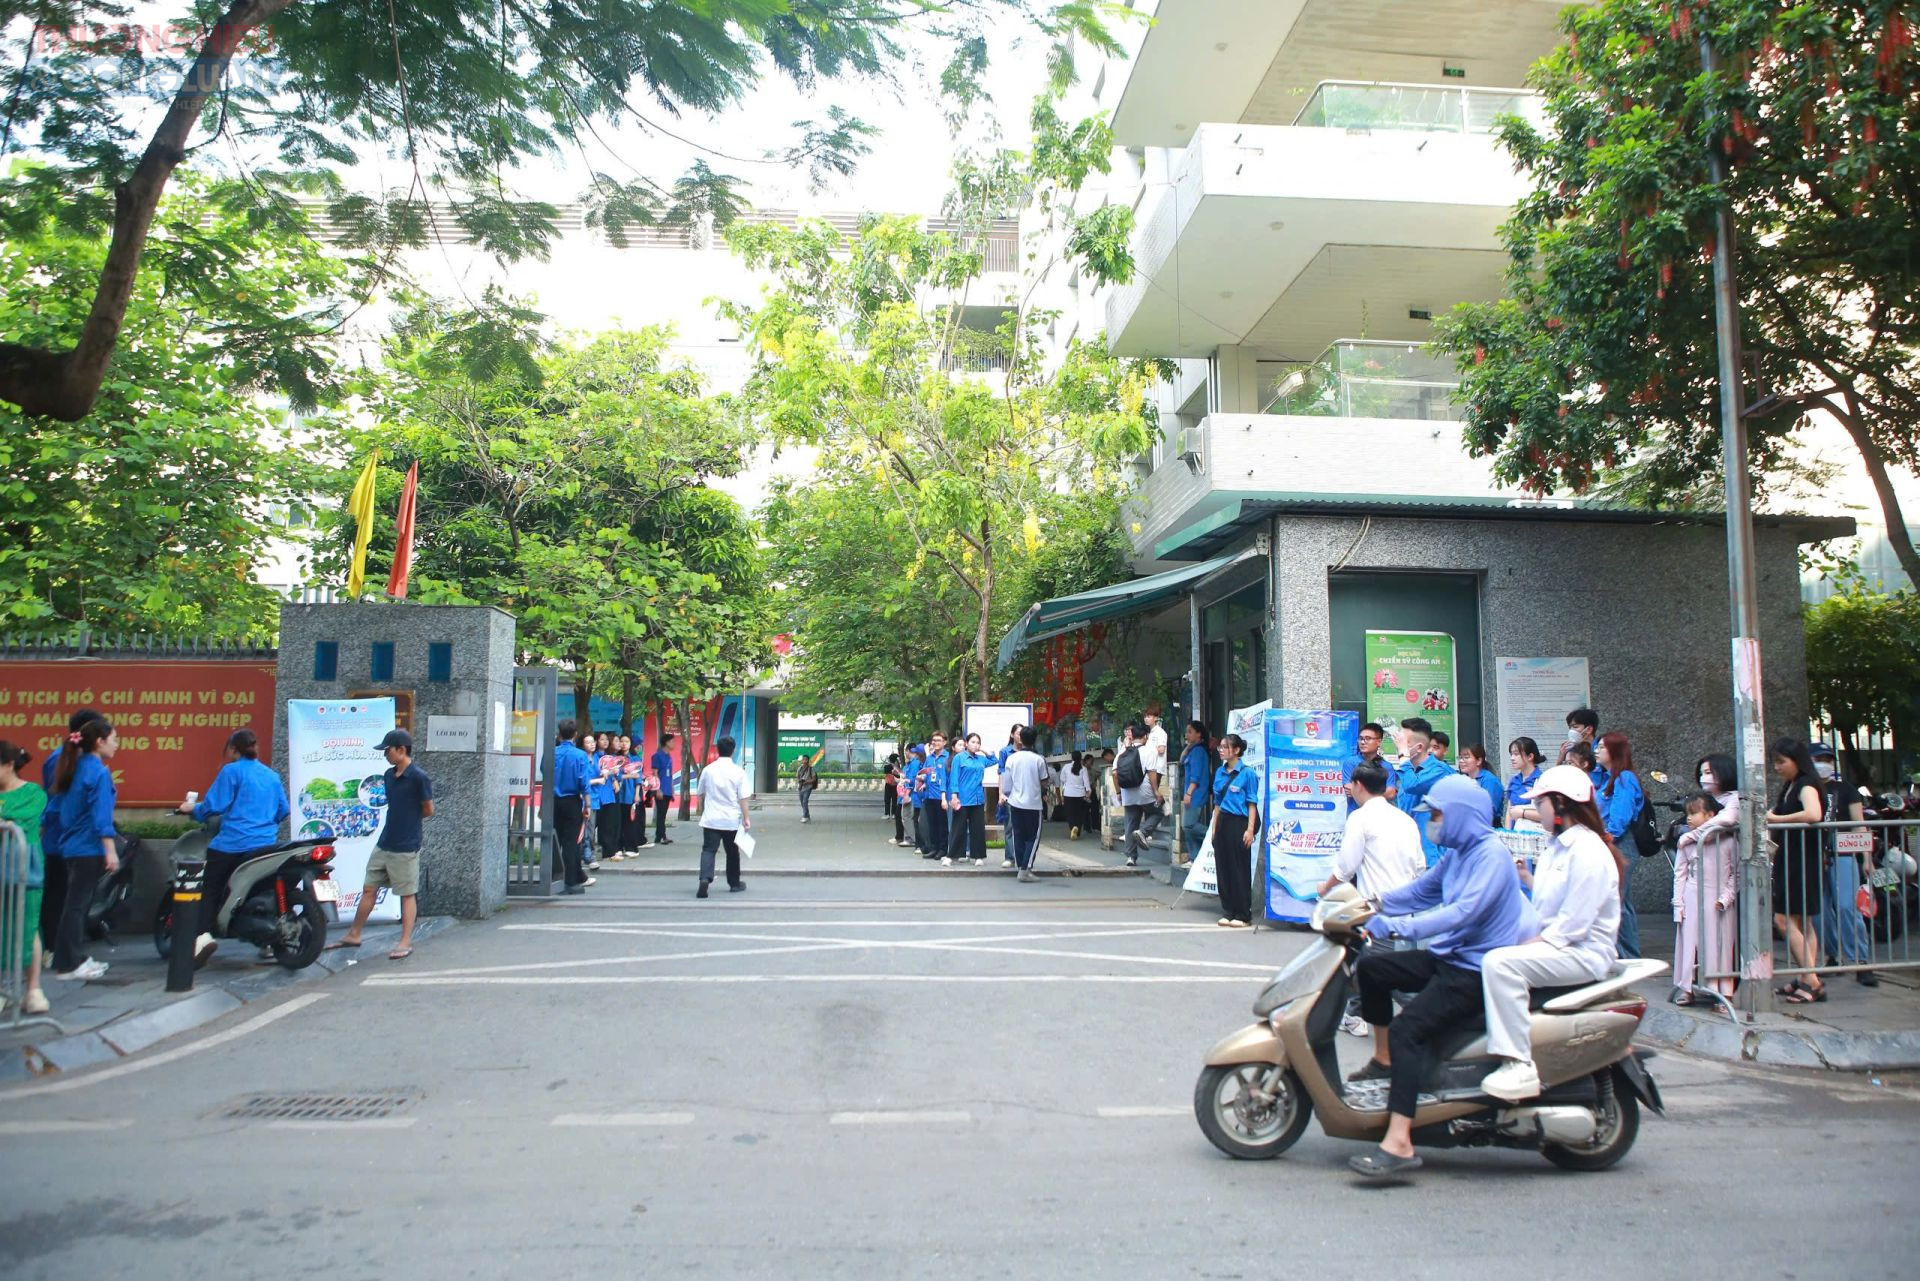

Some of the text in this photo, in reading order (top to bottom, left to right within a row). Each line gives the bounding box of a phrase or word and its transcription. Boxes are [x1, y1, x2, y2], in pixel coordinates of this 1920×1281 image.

[17, 691, 59, 707] TỊCH
[101, 688, 133, 704] CHÍ
[140, 691, 192, 704] MINH
[223, 691, 255, 707] ĐẠI
[149, 713, 175, 730] SỰ
[180, 711, 251, 730] NGHIỆP
[38, 733, 63, 750] CỦ
[156, 736, 184, 750] TA!
[1276, 767, 1308, 780] TIẾP
[1277, 780, 1344, 794] MÙA THI
